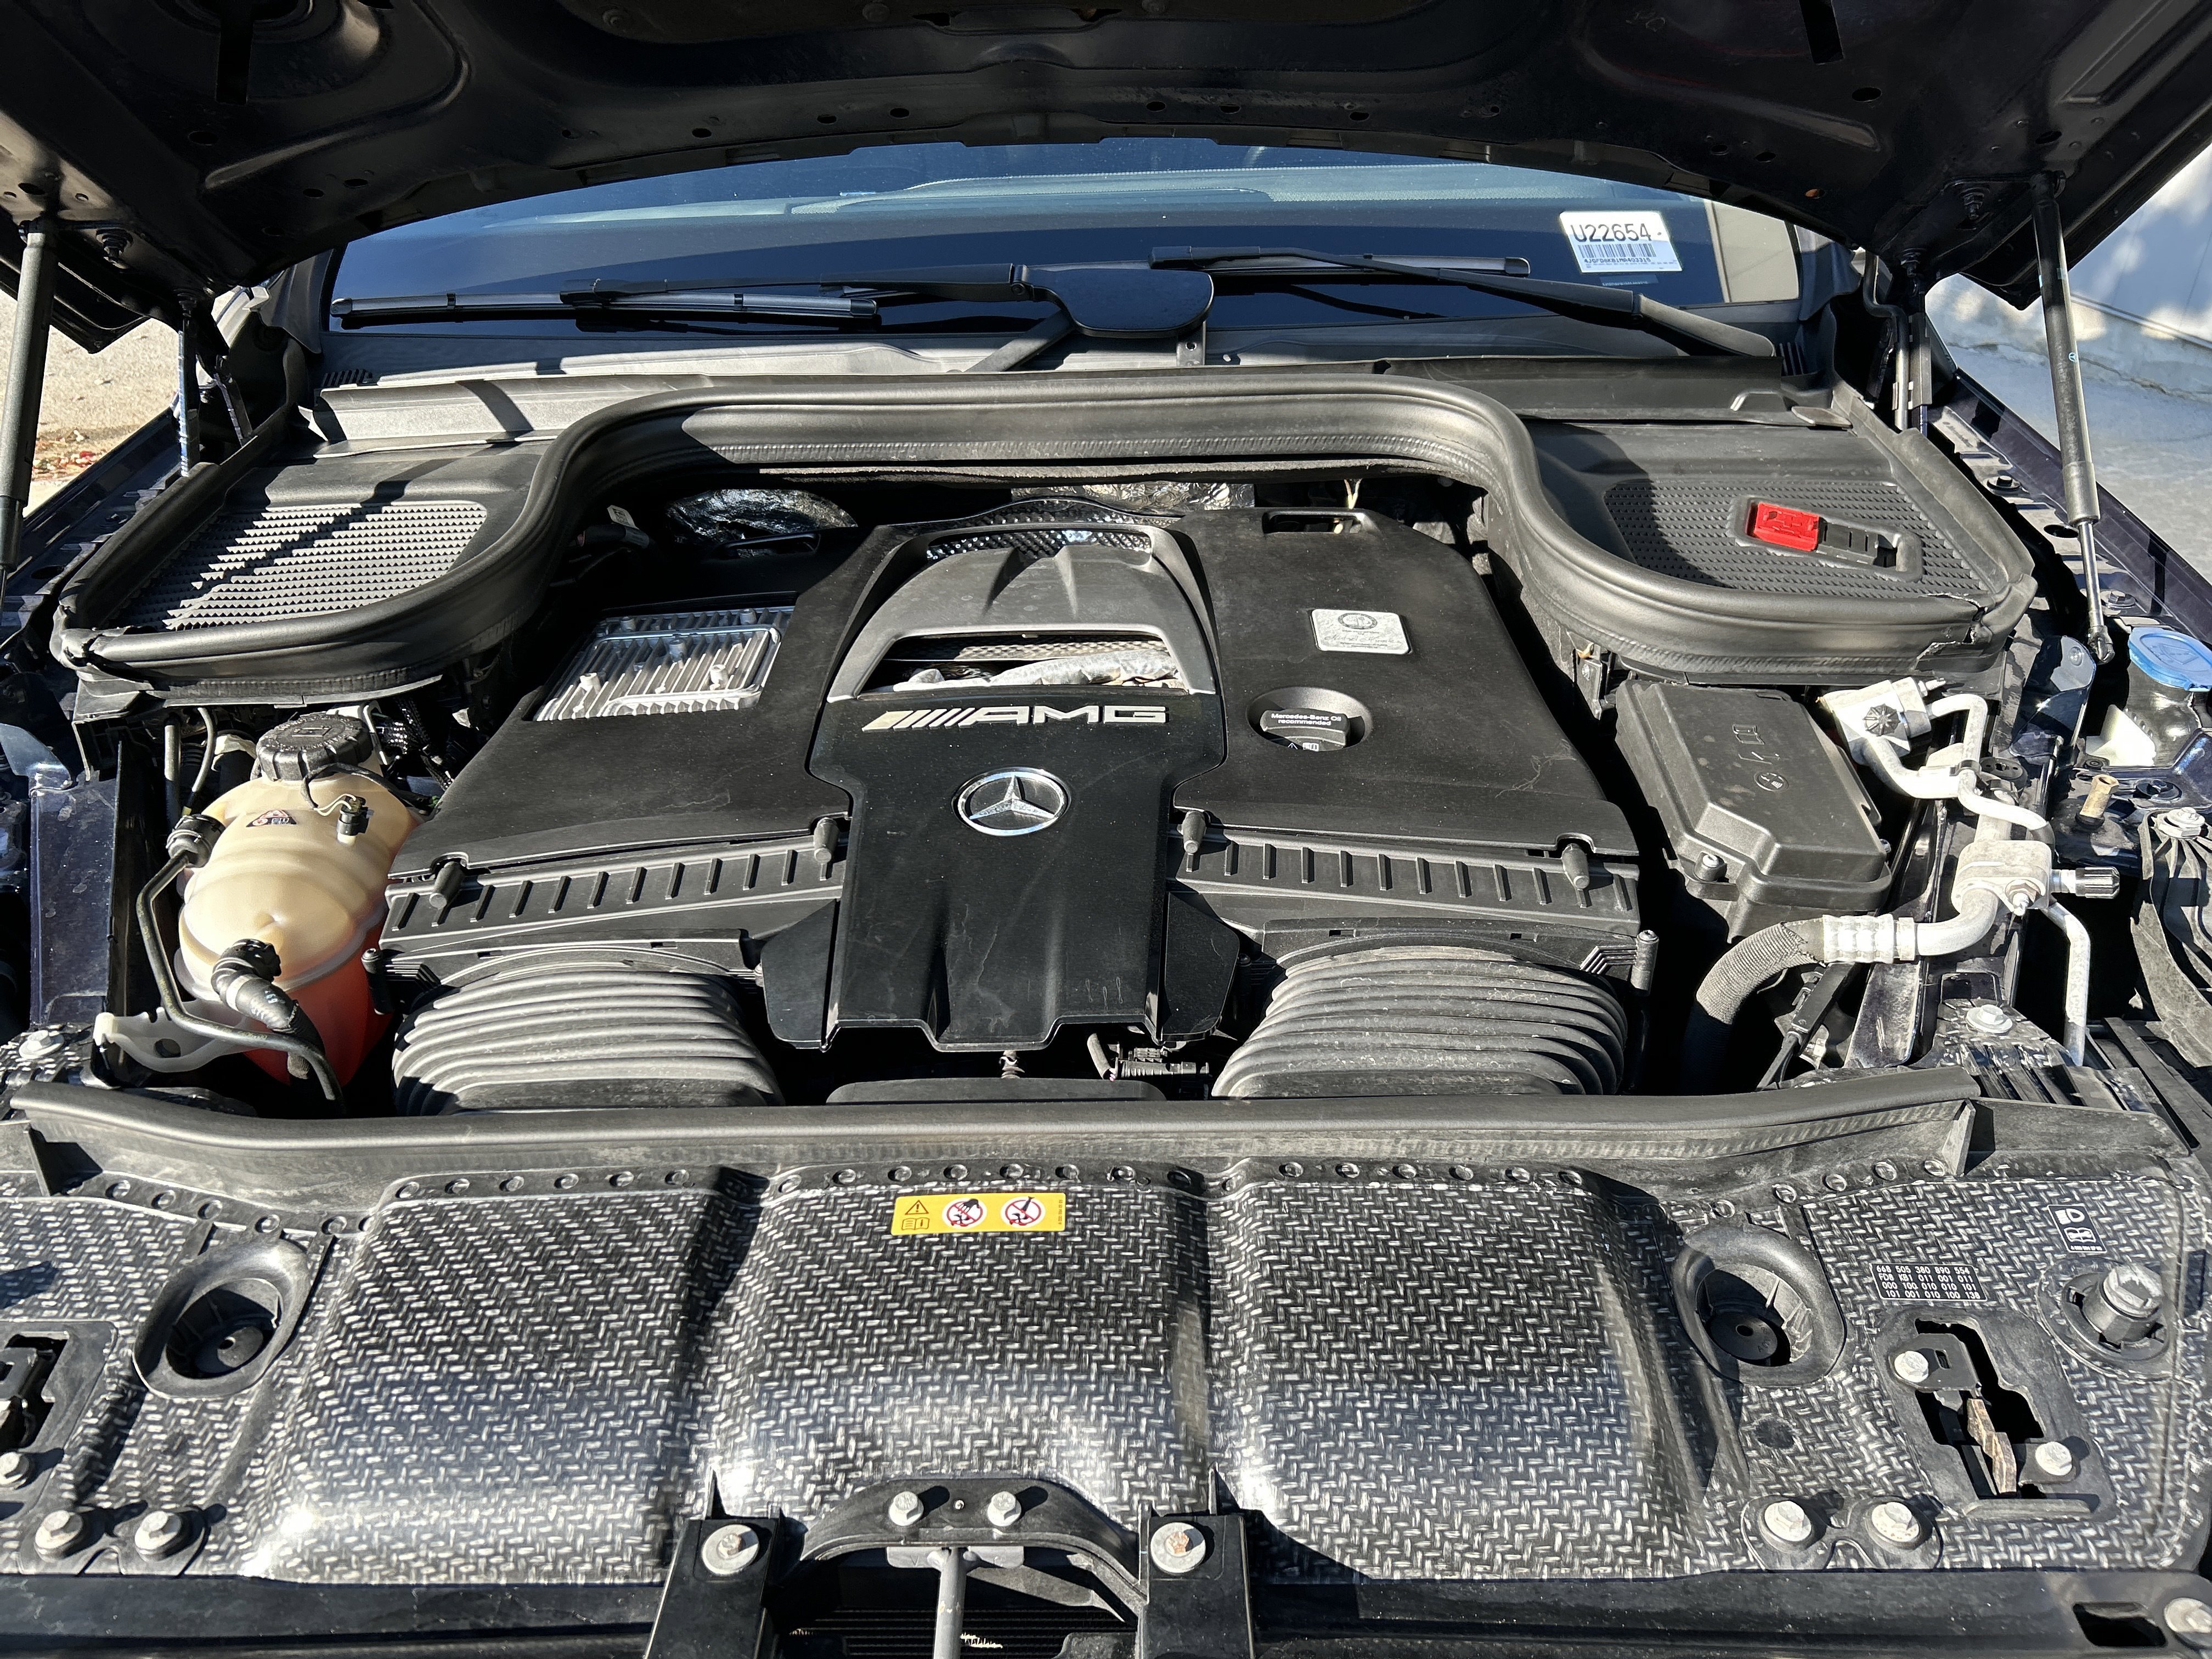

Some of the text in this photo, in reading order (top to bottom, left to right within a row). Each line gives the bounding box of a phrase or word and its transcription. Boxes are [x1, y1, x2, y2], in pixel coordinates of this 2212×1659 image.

[1570, 223, 1652, 242] U22654
[958, 706, 1166, 727] AMG
[1914, 1266, 1931, 1274] 380
[1886, 1290, 1900, 1298] 101
